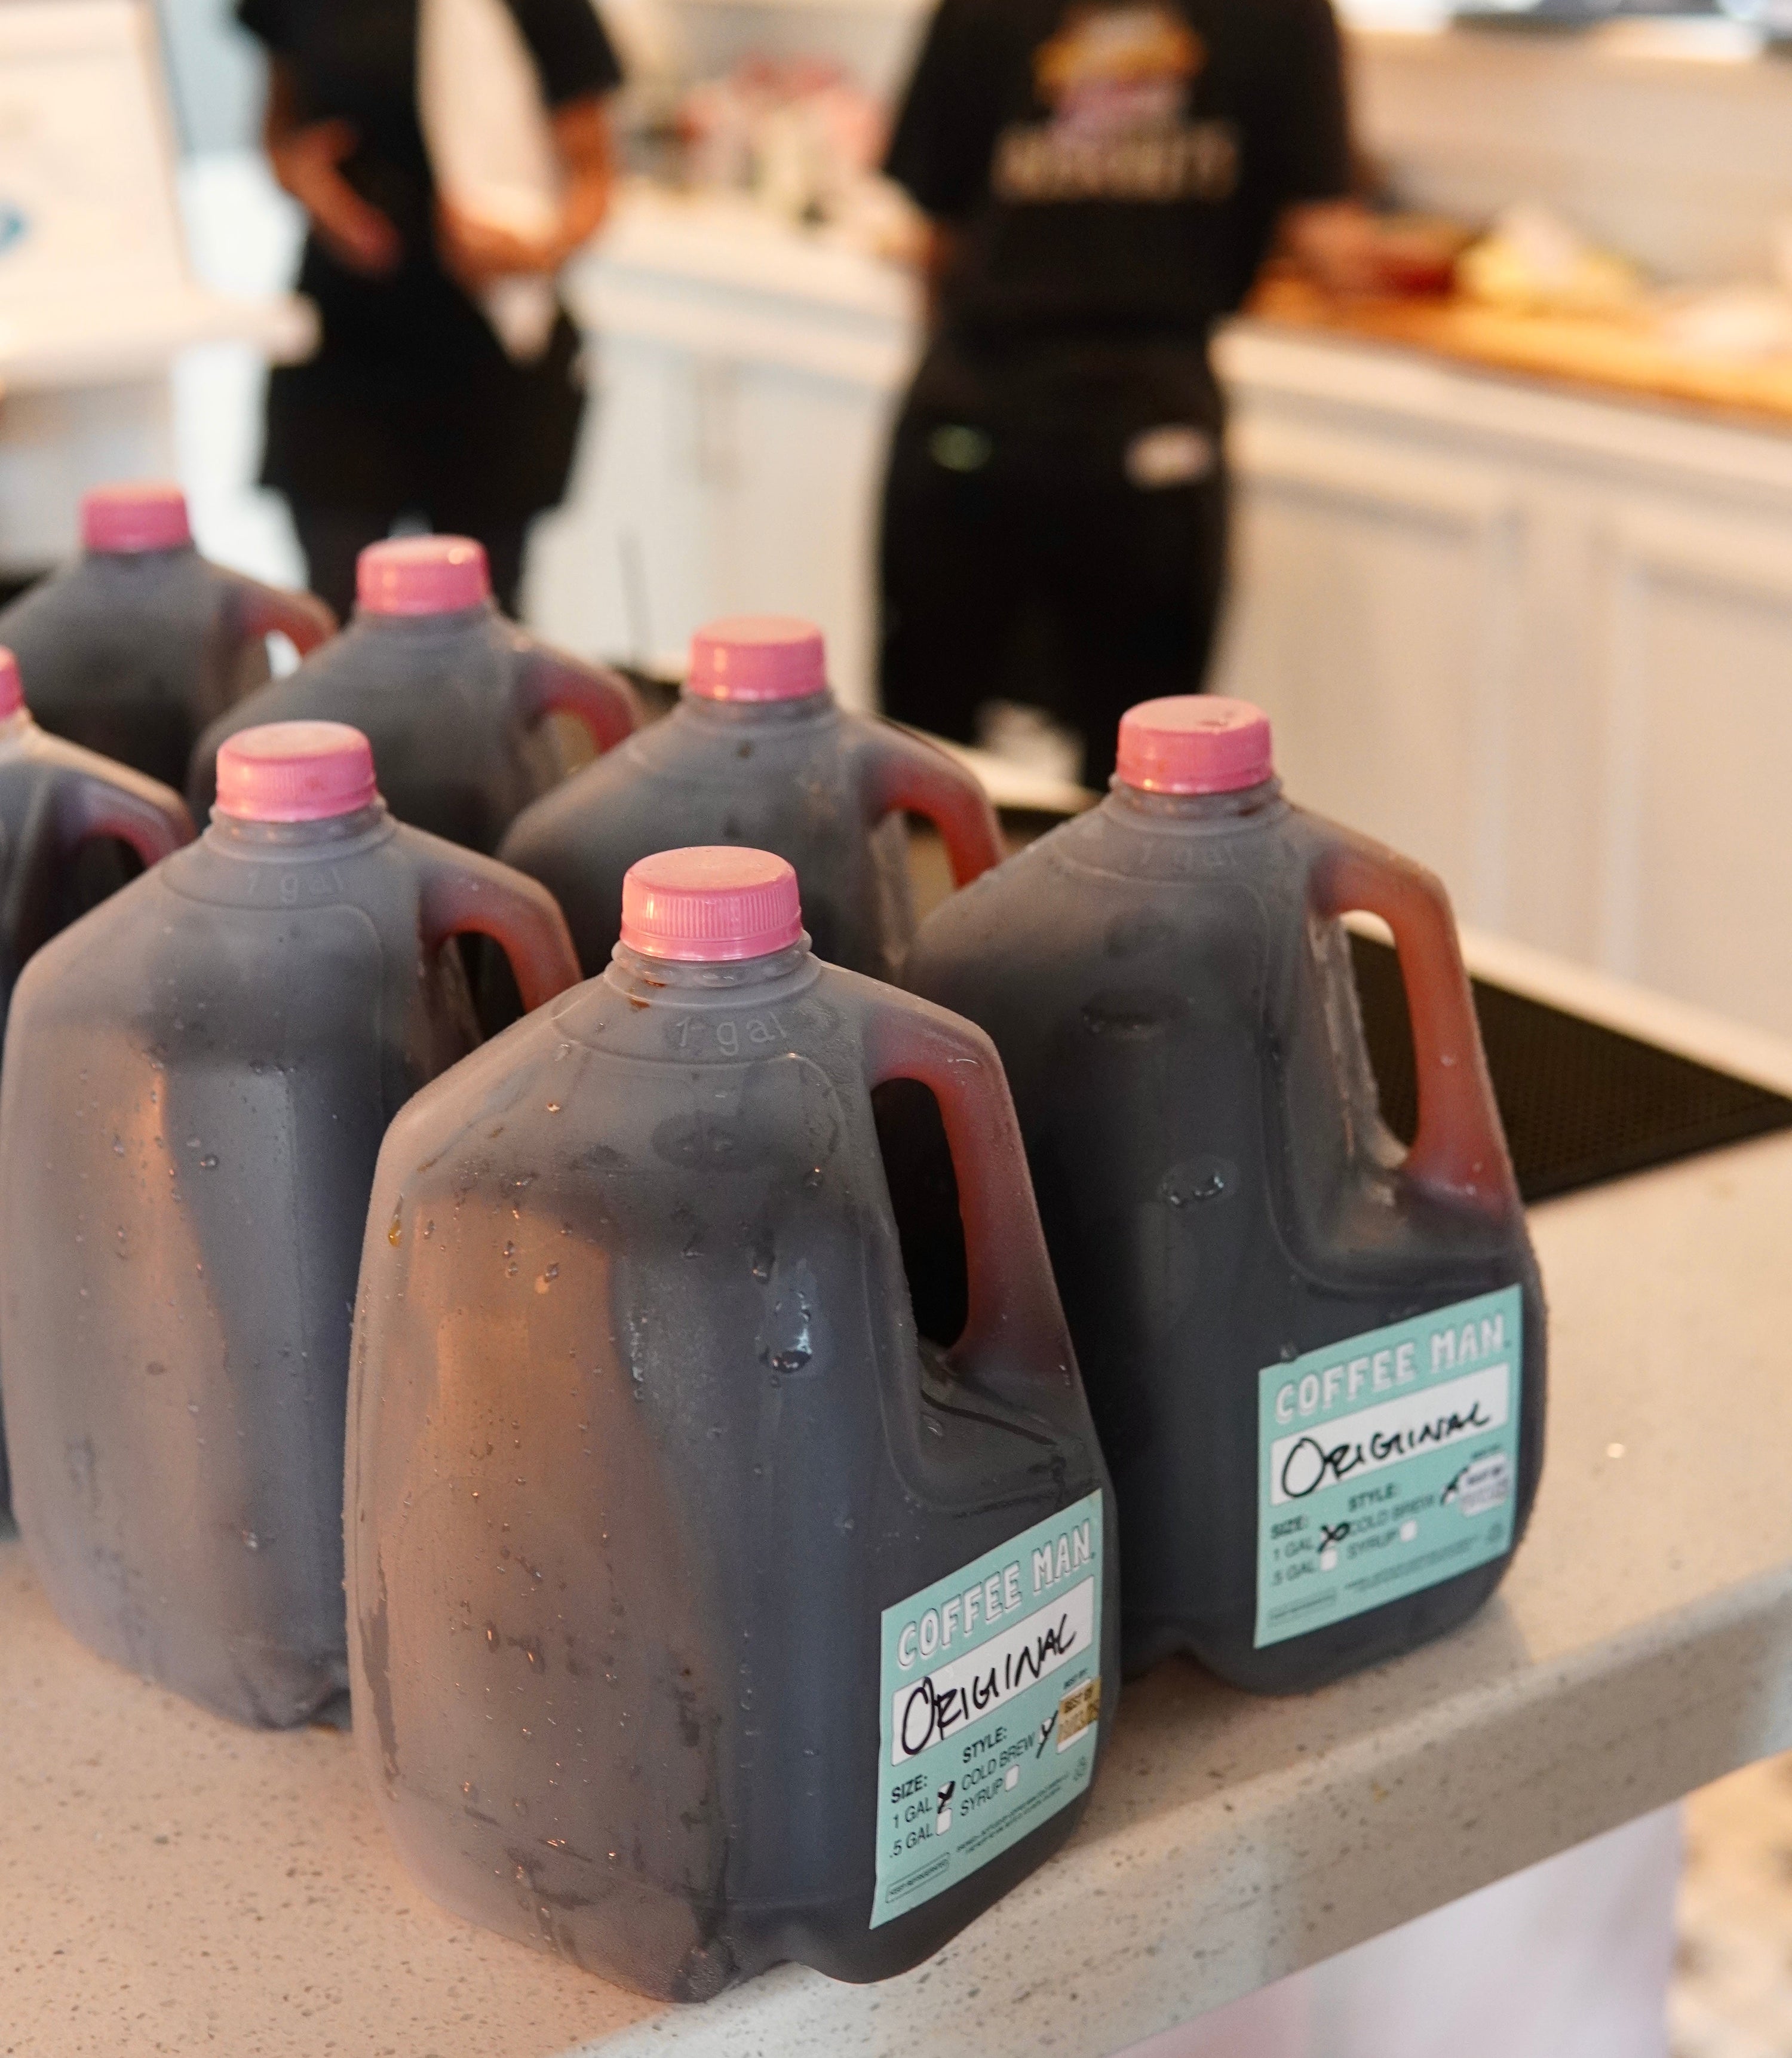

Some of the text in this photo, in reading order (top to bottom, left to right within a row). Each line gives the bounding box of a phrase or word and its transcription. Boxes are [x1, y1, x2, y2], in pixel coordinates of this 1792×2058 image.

[717, 1011, 788, 1056] gal
[1275, 1310, 1505, 1424] COFFEE MAN
[1284, 1537, 1314, 1559] GAL
[1285, 1560, 1315, 1582] GAL
[898, 1517, 1092, 1670] COFFEE MAN
[961, 1731, 1036, 1791] COLD BREW
[962, 1726, 1007, 1764] STYLE:
[891, 1772, 928, 1804] SIZE:
[959, 1778, 1005, 1817] SYRUP
[893, 1797, 933, 1829] 1 GAL
[889, 1823, 934, 1858] .5 GAL
